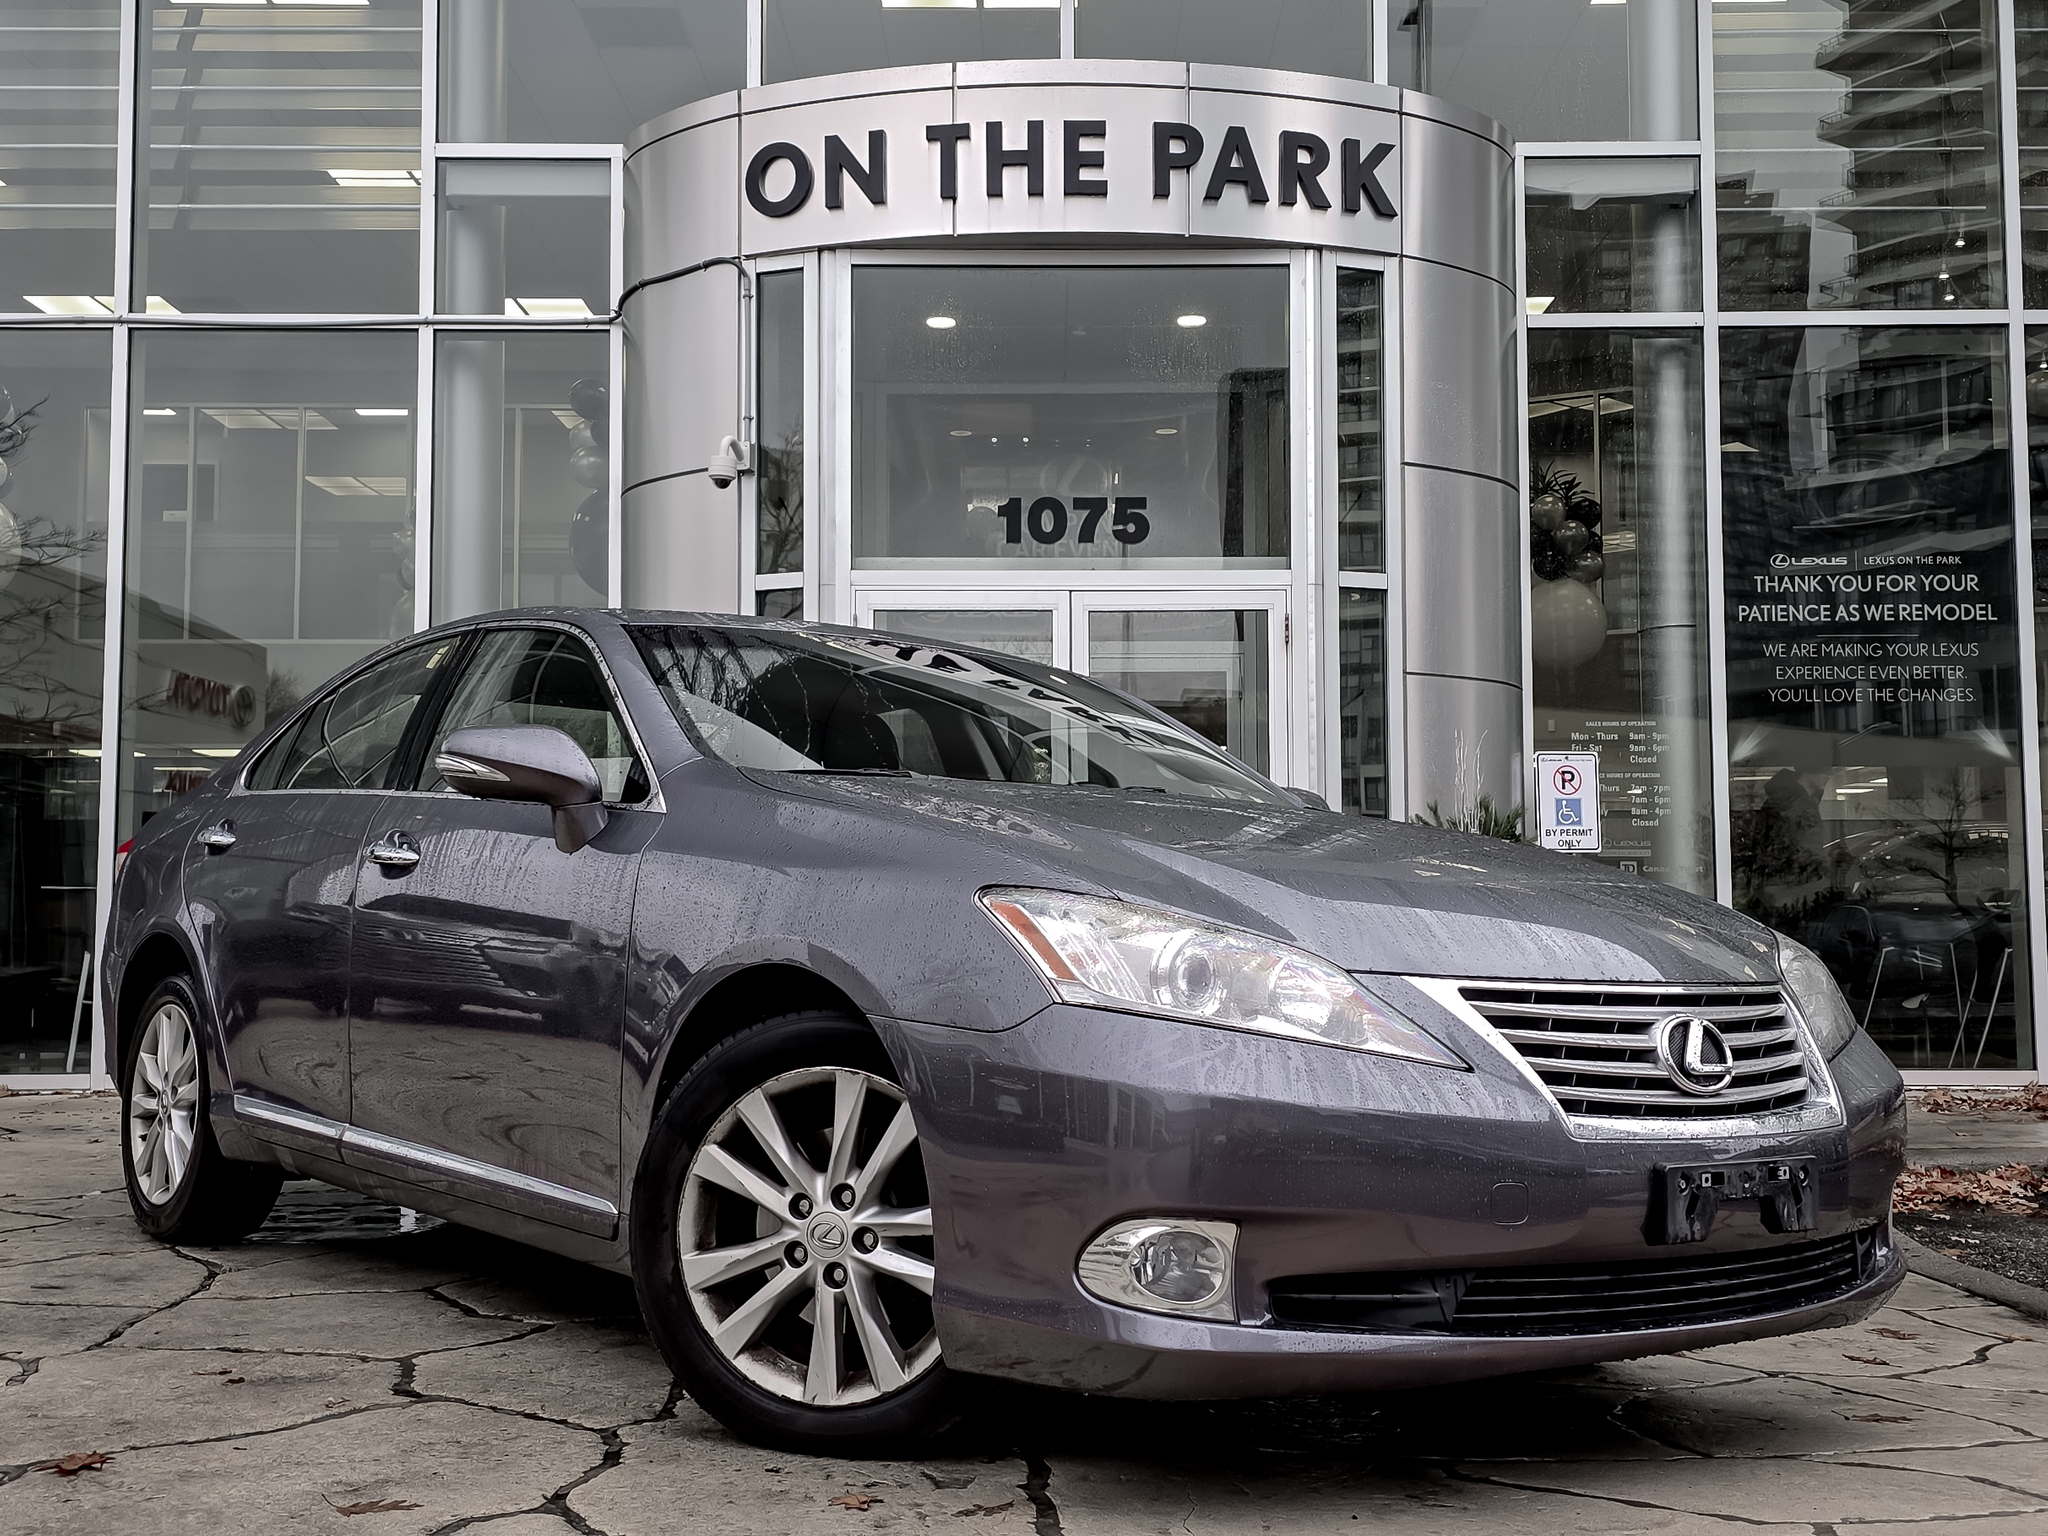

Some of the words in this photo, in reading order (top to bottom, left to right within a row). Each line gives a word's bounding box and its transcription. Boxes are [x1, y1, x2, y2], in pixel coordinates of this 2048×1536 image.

[745, 129, 887, 218] ON
[926, 120, 1108, 201] THE
[1152, 121, 1398, 218] PARK
[997, 496, 1150, 545] 1075
[1791, 556, 1848, 565] LEXUS
[1864, 556, 1895, 565] LEXUS
[1897, 556, 1913, 565] ON
[1915, 556, 1934, 565] THE
[1937, 555, 1962, 564] PARK
[1753, 575, 1823, 592] THANK
[1827, 574, 1872, 592] YOU
[1876, 574, 1917, 592] FOR
[1920, 574, 1980, 592] YOUR
[1738, 604, 1831, 622] PATIENCE
[1835, 604, 1860, 621] AS
[1863, 604, 1895, 621] WE
[1899, 603, 1998, 621] REMODEL
[1763, 643, 1787, 658] WE
[1790, 643, 1818, 657] ARE
[1821, 643, 1882, 657] MAKING
[1885, 643, 1929, 657] YOUR
[1932, 643, 1979, 657] LEXUS
[1776, 665, 1866, 680] EXPERIENCE
[1870, 665, 1909, 680] EVEN
[1913, 665, 1968, 679] BETTER.
[1768, 688, 1822, 702] YOU'LL
[1825, 688, 1863, 702] LOVE
[1866, 688, 1894, 702] THE
[1898, 688, 1977, 702] CHANGES.
[1571, 732, 1589, 740] Mon
[1596, 732, 1619, 740] Thurs
[1629, 732, 1646, 740] 9am
[1652, 732, 1670, 741] 9pm
[1571, 743, 1582, 752] Fri
[1589, 743, 1603, 752] Sat
[1629, 743, 1646, 752] 9am
[1652, 743, 1670, 753] 6pm
[1630, 755, 1657, 763] Closed
[1653, 784, 1671, 793] 7pm
[1631, 795, 1648, 803] 7am
[1631, 807, 1648, 815] 8am
[1654, 807, 1672, 816] 4pm
[1631, 818, 1659, 827] Closed
[1545, 829, 1558, 837] BY
[1560, 829, 1593, 837] PERMIT
[1557, 839, 1582, 848] ONLY
